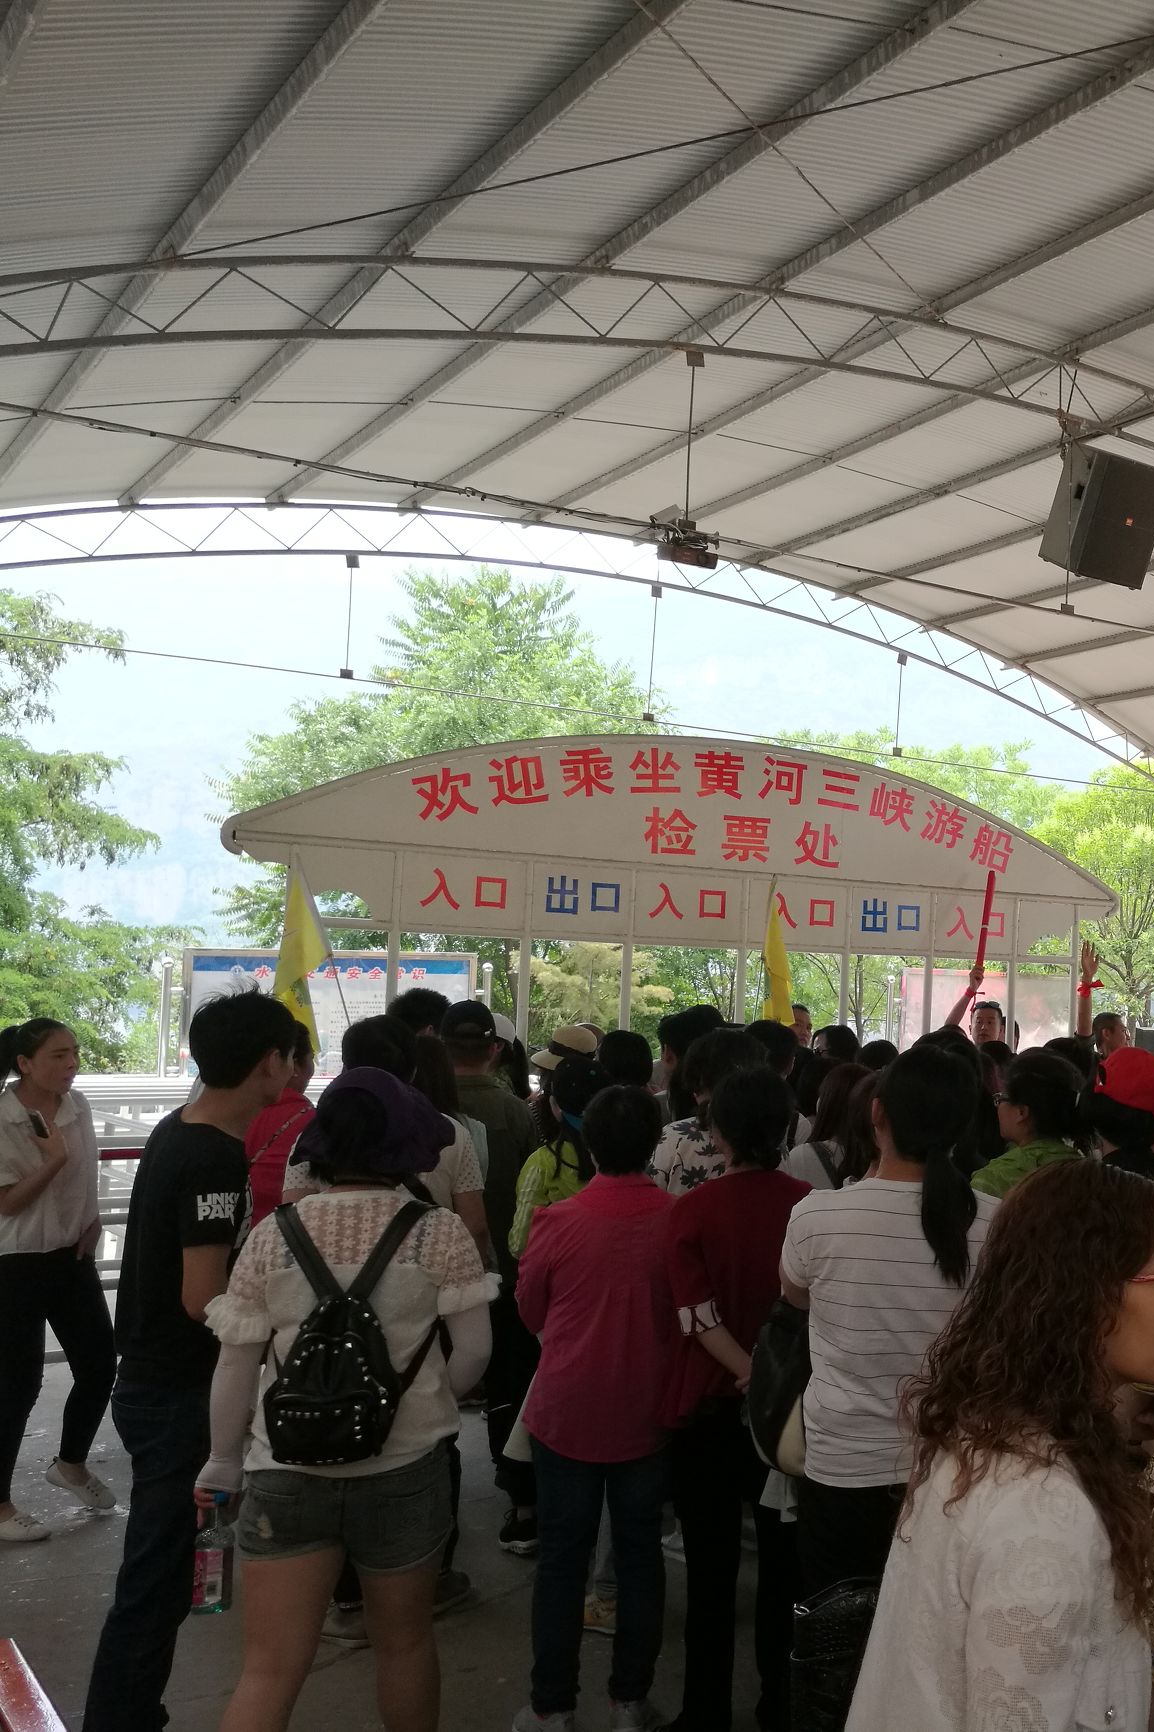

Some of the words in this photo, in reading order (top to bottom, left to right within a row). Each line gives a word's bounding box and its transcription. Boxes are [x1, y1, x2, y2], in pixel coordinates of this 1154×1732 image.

[411, 746, 1015, 874] 欢迎乘坐黄河三峡游船
[643, 806, 840, 869] 检票处
[419, 867, 508, 911] 入口
[545, 875, 621, 916] 出口
[648, 881, 727, 920] 入口
[775, 891, 835, 929] 入口
[861, 898, 920, 933] 出口
[254, 965, 427, 981] 水通安全识
